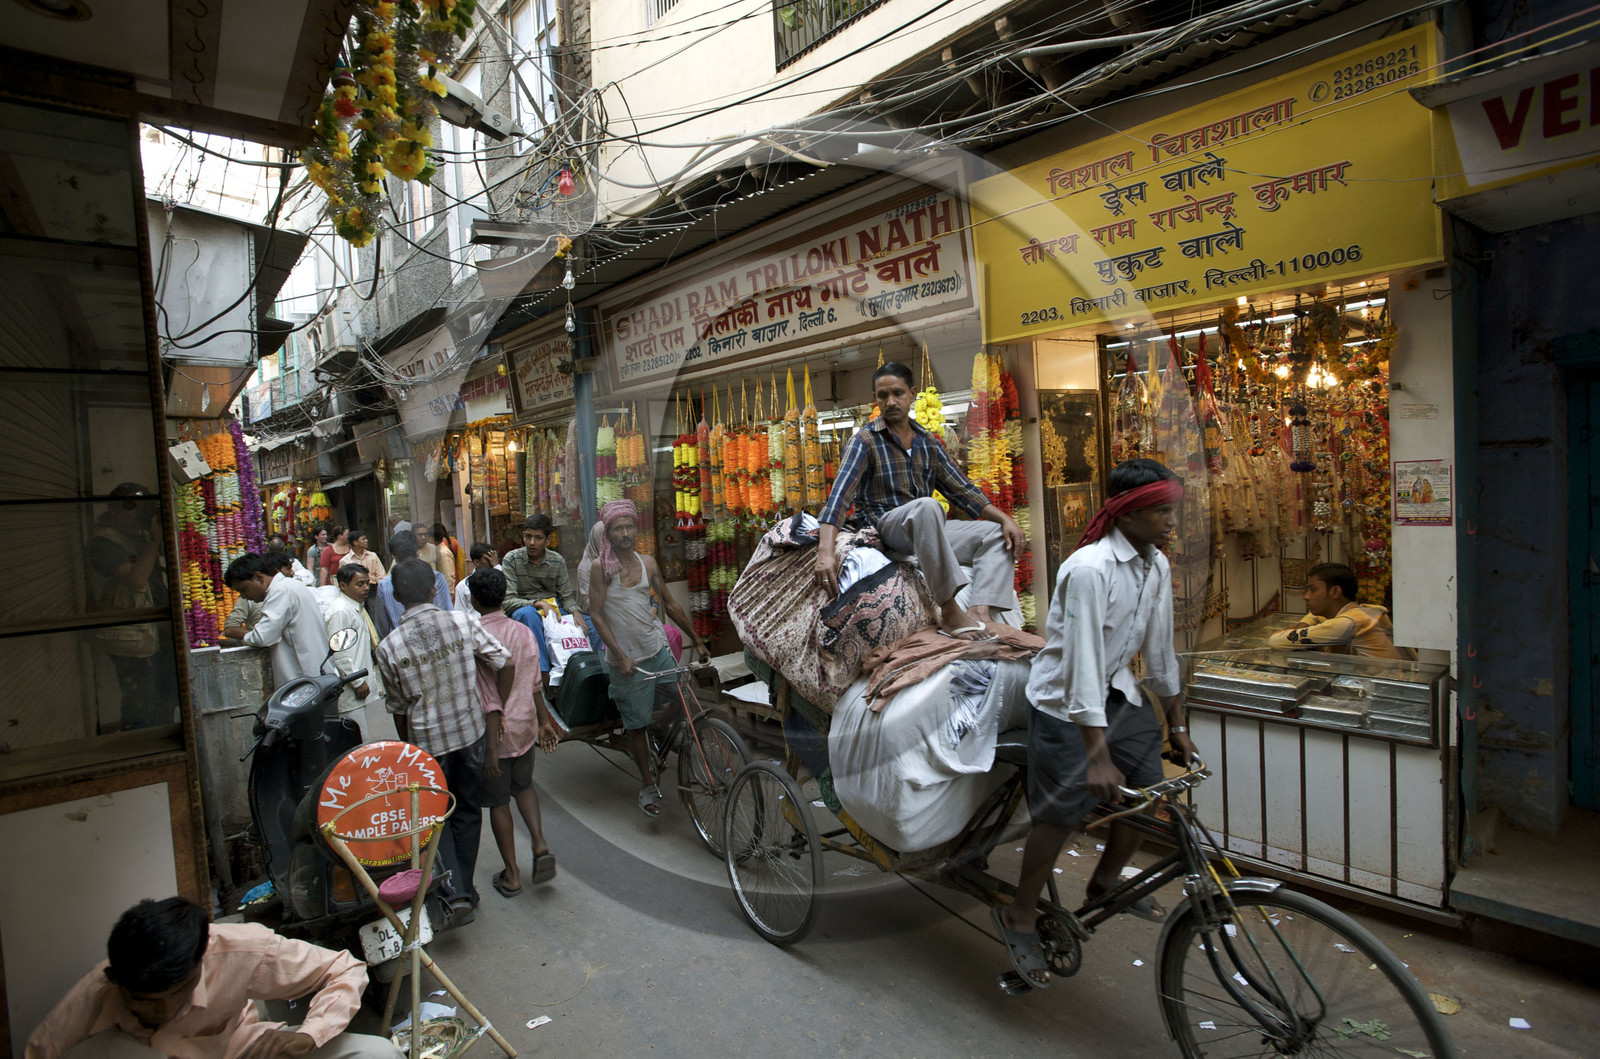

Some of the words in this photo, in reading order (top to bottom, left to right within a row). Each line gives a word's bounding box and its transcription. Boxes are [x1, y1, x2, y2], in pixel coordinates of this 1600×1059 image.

[1333, 44, 1417, 85] 23269221
[1333, 61, 1419, 100] 23283085
[1046, 151, 1135, 195] विशाल
[1147, 97, 1297, 162] चित्रशाला
[1019, 233, 1079, 265] तीरथ
[1089, 218, 1137, 247] राम
[1148, 191, 1237, 231] राजेन्द्र
[1249, 160, 1352, 212] कुमार
[1100, 181, 1148, 216] ड्रेस
[1160, 152, 1227, 191] वाले
[616, 297, 683, 341] SHADI
[686, 276, 740, 318] RAM
[746, 237, 850, 298] TRILOKI
[856, 199, 954, 262] NATH
[1093, 246, 1166, 284] मुकुट
[1177, 222, 1246, 258] वाले
[659, 326, 685, 353] राम
[765, 285, 812, 320] नाथ
[873, 240, 943, 285] वाले
[708, 328, 747, 355] किनारी
[894, 283, 919, 310] कुमार
[1021, 306, 1064, 325] 2203,
[1069, 287, 1127, 316] किनारी
[370, 809, 406, 825] CBSE
